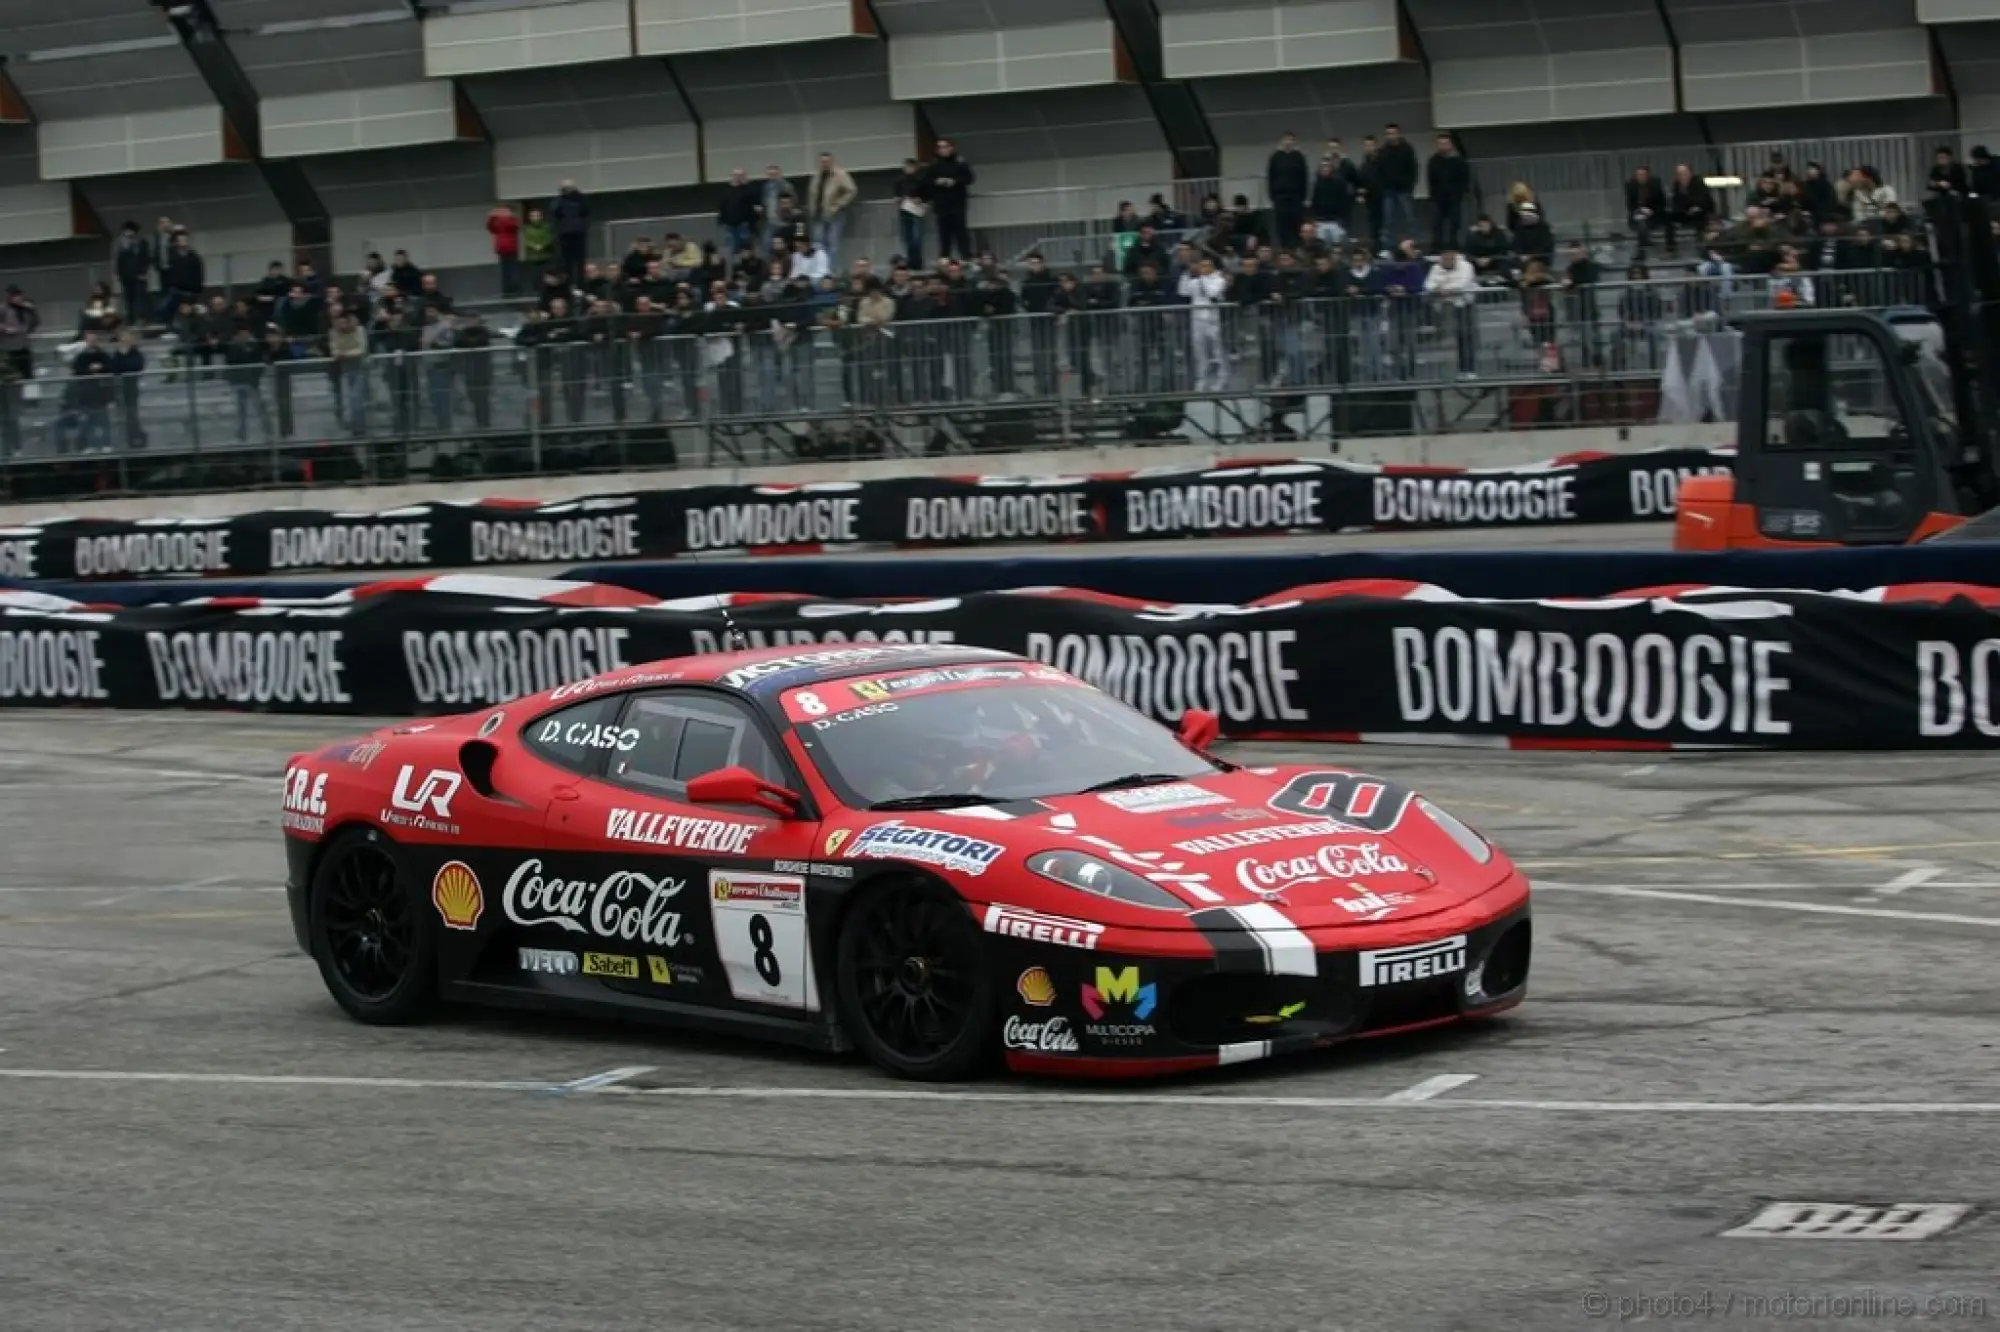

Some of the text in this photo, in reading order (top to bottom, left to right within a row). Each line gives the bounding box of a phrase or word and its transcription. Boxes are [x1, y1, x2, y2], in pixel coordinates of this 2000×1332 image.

[906, 490, 1087, 540] BOMBOOGIE
[1127, 479, 1322, 533] BOMBOOGIE
[1373, 475, 1575, 521] BOMBOOGIE
[1629, 466, 1733, 516] BO
[271, 521, 430, 568] BOMBOOGIE
[471, 512, 640, 562] BOMBOOGIE
[686, 497, 860, 550] BOMBOOGIE
[75, 530, 229, 576] BOMBOOGIE
[146, 630, 351, 704] BOMBOOGIE
[1392, 626, 1793, 735] BOMBOOGIE
[794, 691, 829, 716] 8
[539, 720, 641, 751] D. CASO
[606, 808, 757, 854] VALLEVERDE
[858, 826, 1001, 862] SEGATORI
[1236, 842, 1408, 893] Coca-Cola
[502, 858, 687, 948] Coca-Cola
[984, 901, 1106, 950] PIRELLI
[748, 913, 782, 987] 8
[1359, 934, 1468, 987] PIRELLI
